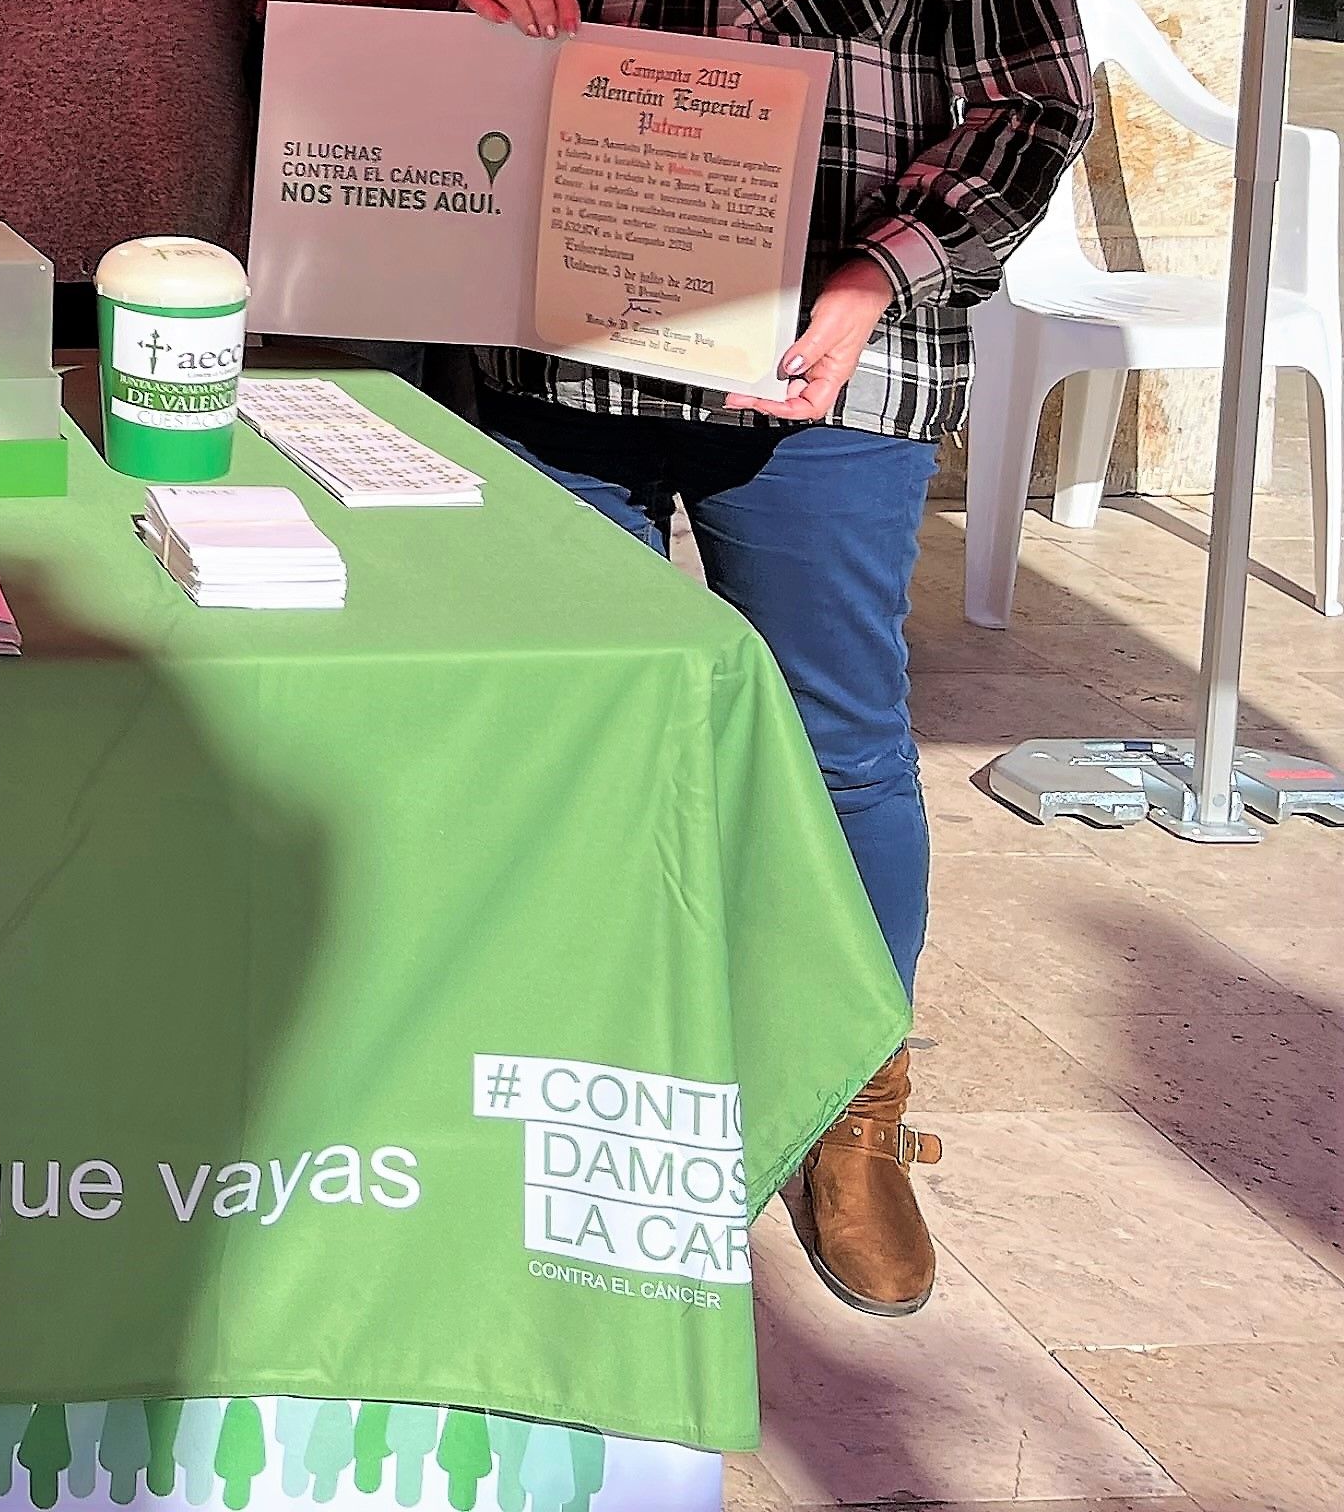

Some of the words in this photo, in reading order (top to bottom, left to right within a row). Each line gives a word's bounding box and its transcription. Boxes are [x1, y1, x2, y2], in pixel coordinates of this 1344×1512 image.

[620, 58, 692, 83] Campaña
[695, 67, 743, 89] 2019
[581, 75, 665, 107] Mención
[673, 88, 754, 120] Especial
[758, 107, 772, 121] a
[639, 110, 703, 139] Paterna
[283, 141, 301, 157] SI
[307, 142, 383, 162] LUCHAS
[282, 161, 358, 181] CONTRA
[363, 166, 385, 182] EL
[390, 164, 468, 190] CÁNCER,
[281, 181, 333, 204] NOS
[340, 185, 428, 210] TIENES
[612, 265, 621, 278] 3
[624, 268, 636, 280] de
[668, 275, 680, 288] de
[684, 277, 714, 295] 2021
[127, 387, 154, 408] DE
[487, 1063, 521, 1108] #
[541, 1067, 744, 1141] CONTI
[158, 1141, 427, 1226] vayas
[544, 1194, 616, 1254] LA
[528, 1259, 608, 1292] CONTRA
[611, 1276, 637, 1299] EL
[640, 1279, 722, 1310] CÁNCER
